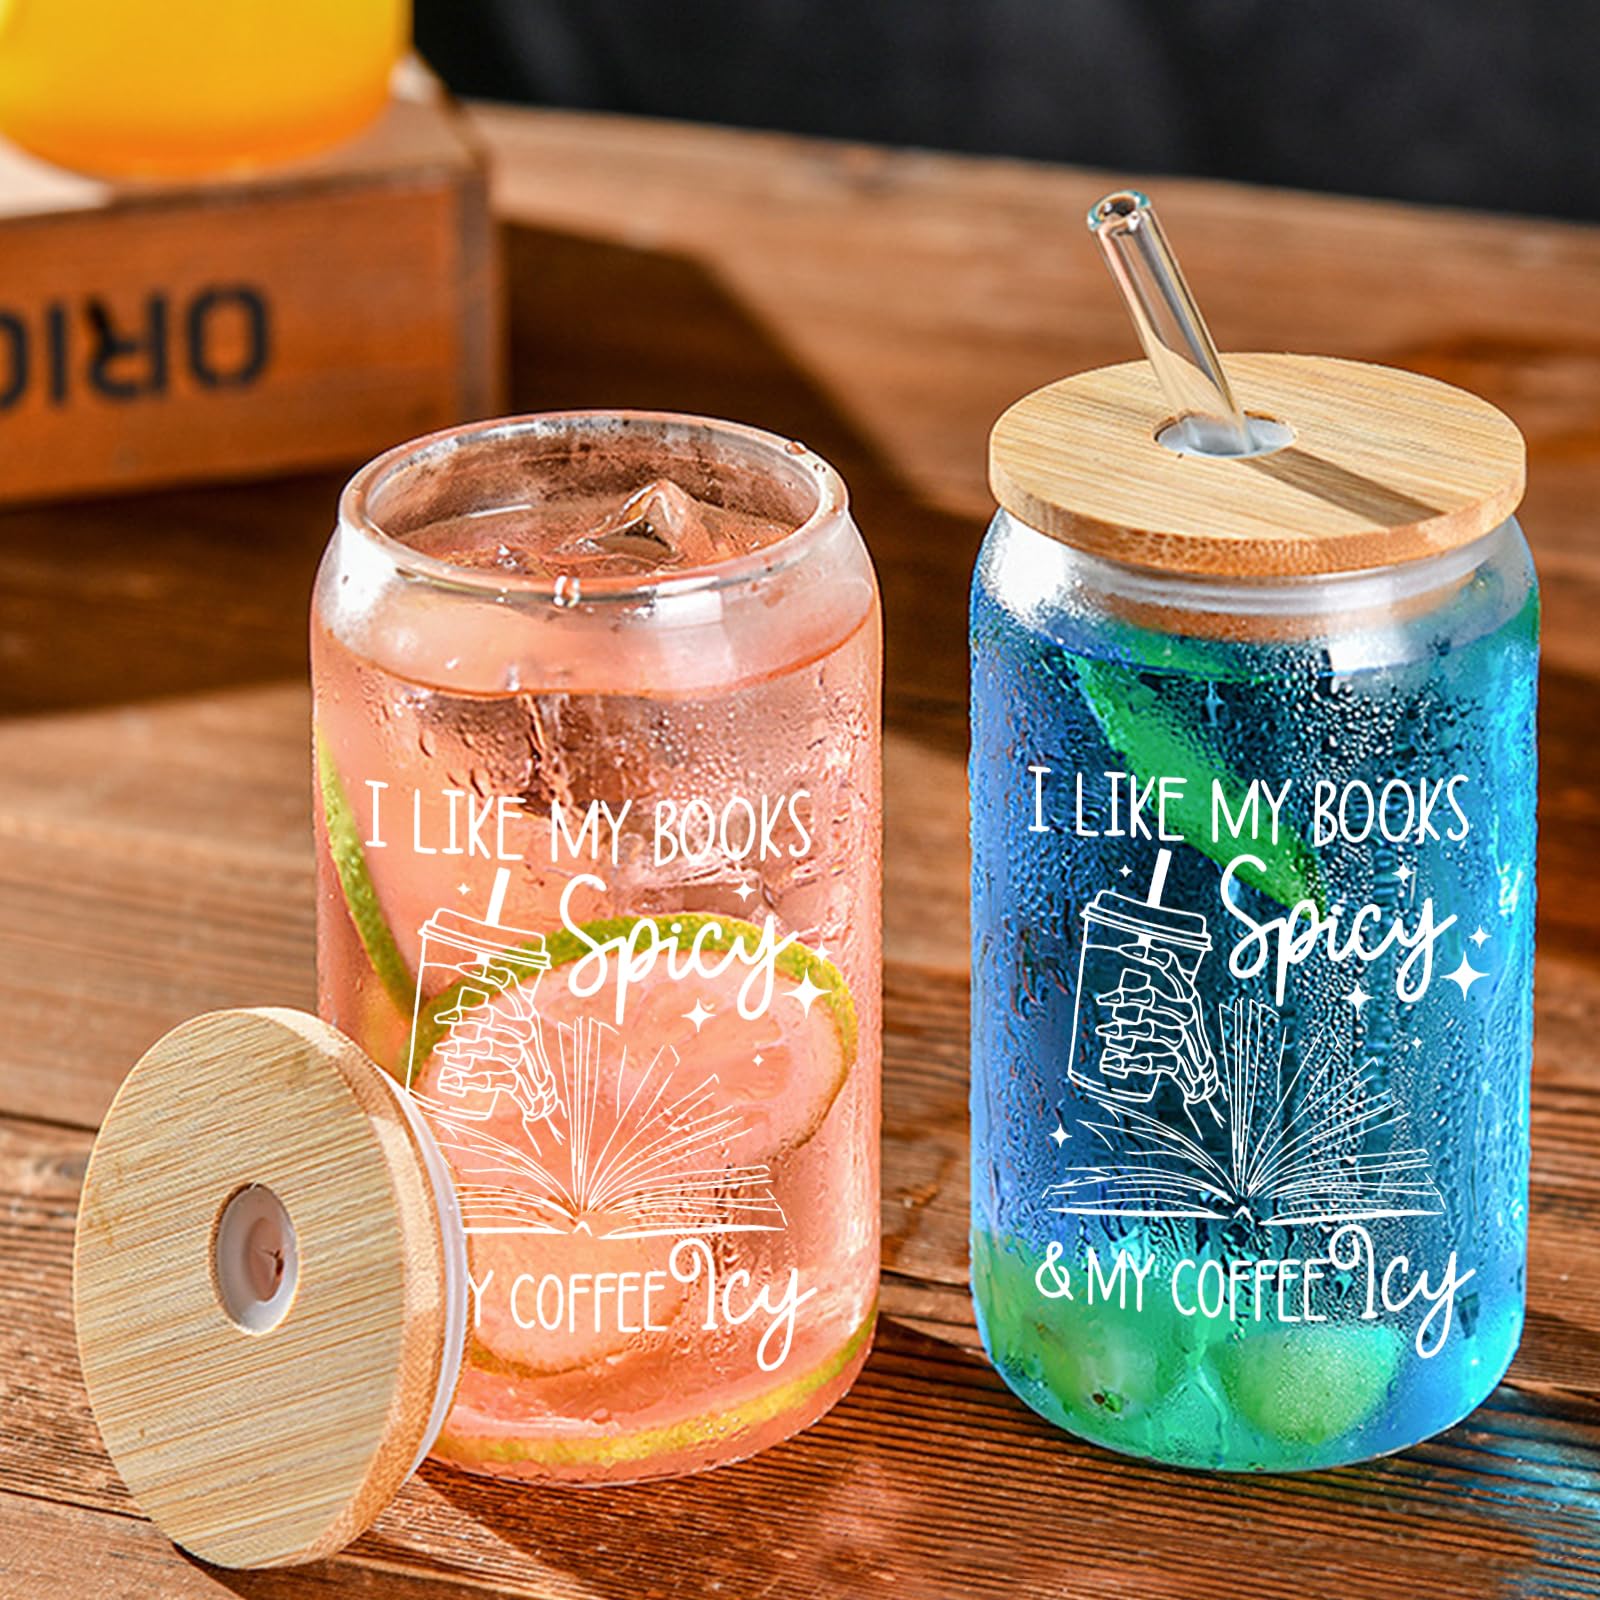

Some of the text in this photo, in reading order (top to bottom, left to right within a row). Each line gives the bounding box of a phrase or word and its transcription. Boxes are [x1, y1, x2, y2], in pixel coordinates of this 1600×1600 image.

[364, 780, 812, 868] I LIKE MY BOOKS
[1027, 765, 1470, 848] I LIKE MY BOOKS
[558, 872, 800, 1026] Spicy
[1219, 853, 1458, 1007] Spicy
[509, 1269, 668, 1333] COFFEE
[668, 1236, 819, 1372] Icy
[1034, 1222, 1477, 1360] & MY COFFEE Icy
